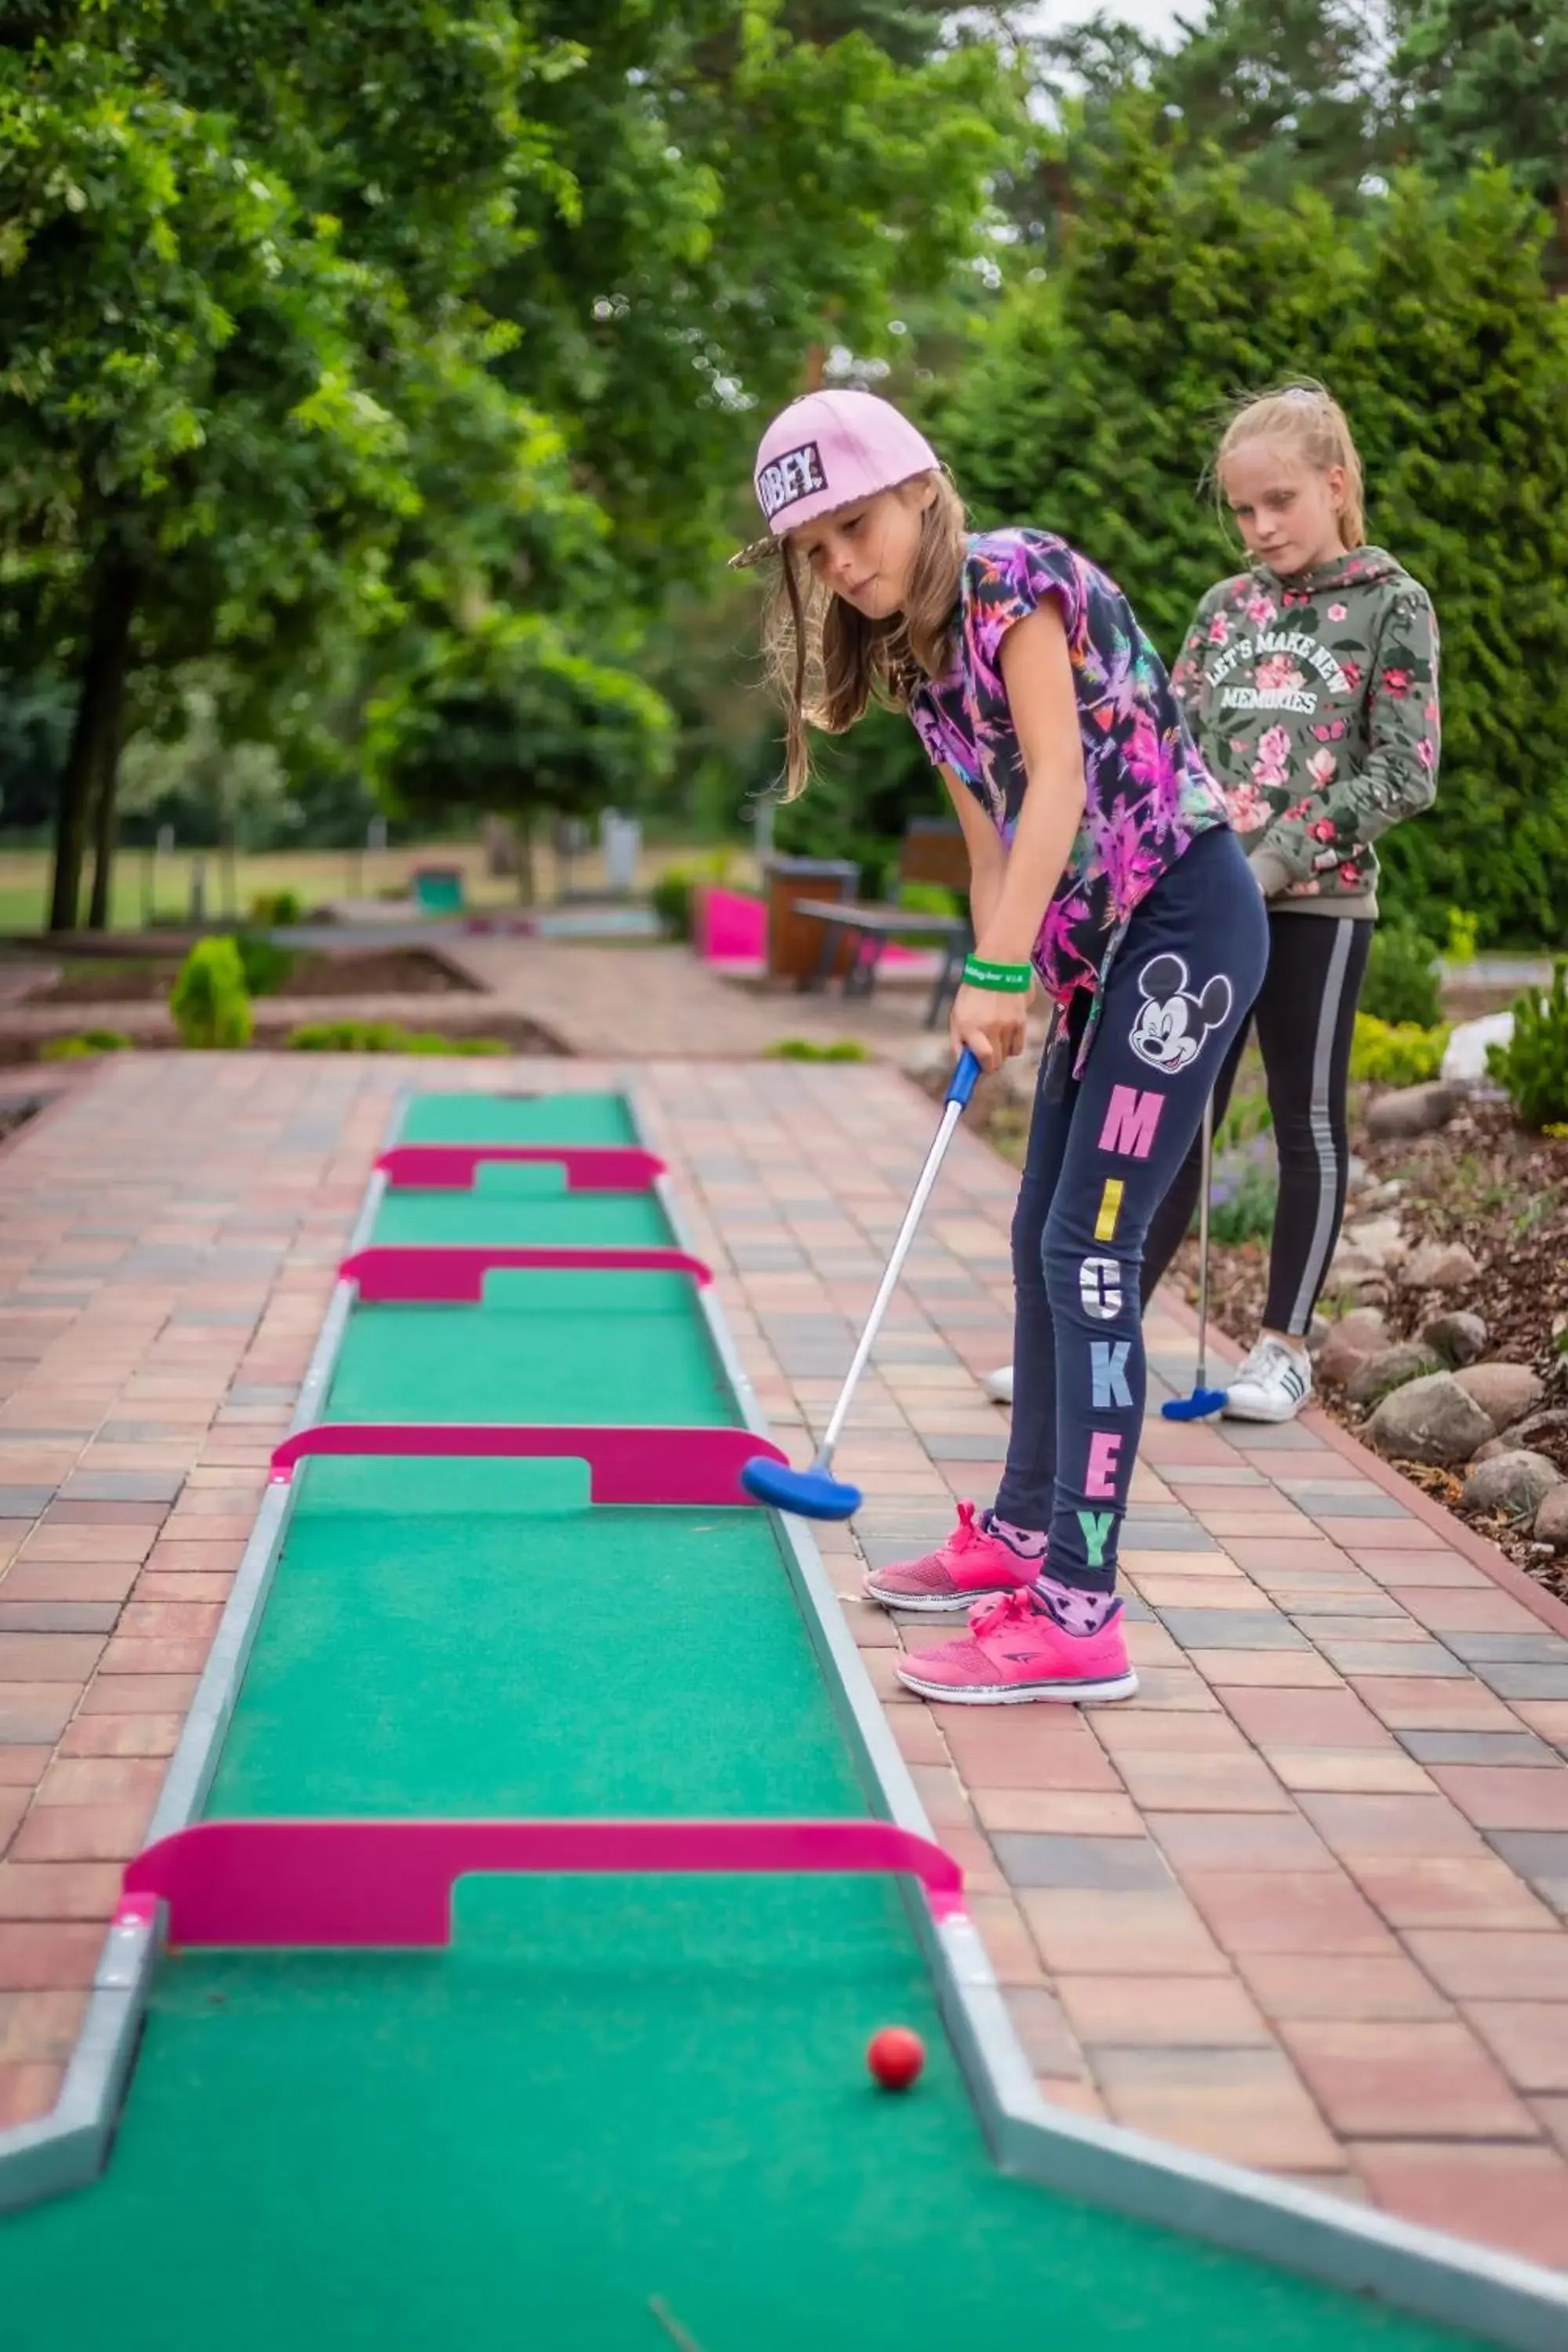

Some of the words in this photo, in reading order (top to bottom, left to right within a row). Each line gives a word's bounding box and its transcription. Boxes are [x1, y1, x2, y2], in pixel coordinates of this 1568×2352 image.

[1204, 639, 1253, 688] LET'S
[1256, 631, 1316, 659] MAKE
[1308, 645, 1352, 694] NEW
[1220, 687, 1318, 715] MEMORIES
